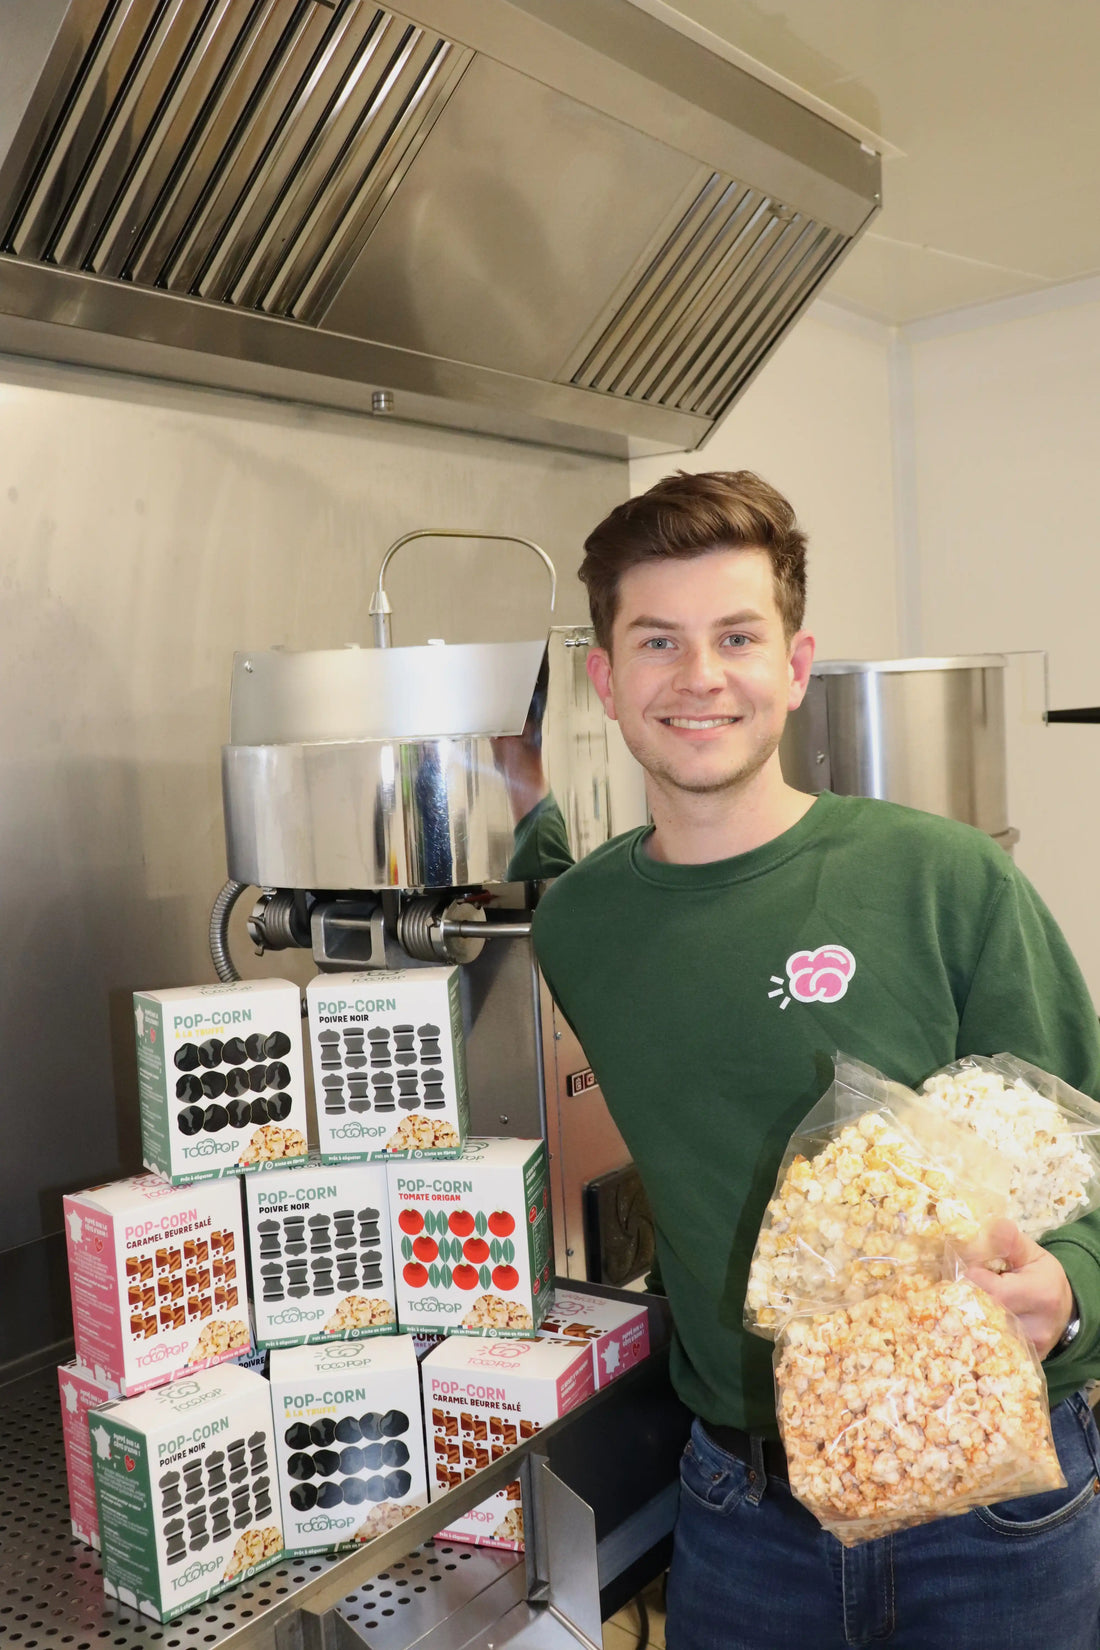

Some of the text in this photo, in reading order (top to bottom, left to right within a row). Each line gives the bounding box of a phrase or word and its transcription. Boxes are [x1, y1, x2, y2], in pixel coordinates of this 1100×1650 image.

[318, 998, 396, 1014] POP-CORN
[174, 1009, 252, 1029] POP-CORN
[320, 1014, 369, 1023] POIVRE NOIR
[258, 1186, 337, 1205] POP-CORN
[397, 1178, 473, 1193] POP-CORN
[398, 1193, 461, 1202] TOMATE ORIGAN
[259, 1202, 310, 1214] POIVRE NOIR
[125, 1208, 198, 1240] POP-CORN
[126, 1216, 212, 1249] CARAMEL BEURRE SALÉ
[284, 1388, 366, 1409] POP-CORN
[432, 1378, 506, 1401] POP-CORN
[433, 1394, 522, 1412] CARAMEL BEURRE SALÉ
[158, 1416, 230, 1458] POP-CORN
[159, 1442, 206, 1467] POIVRE NOIR
[295, 1514, 355, 1534] TOCOPOP
